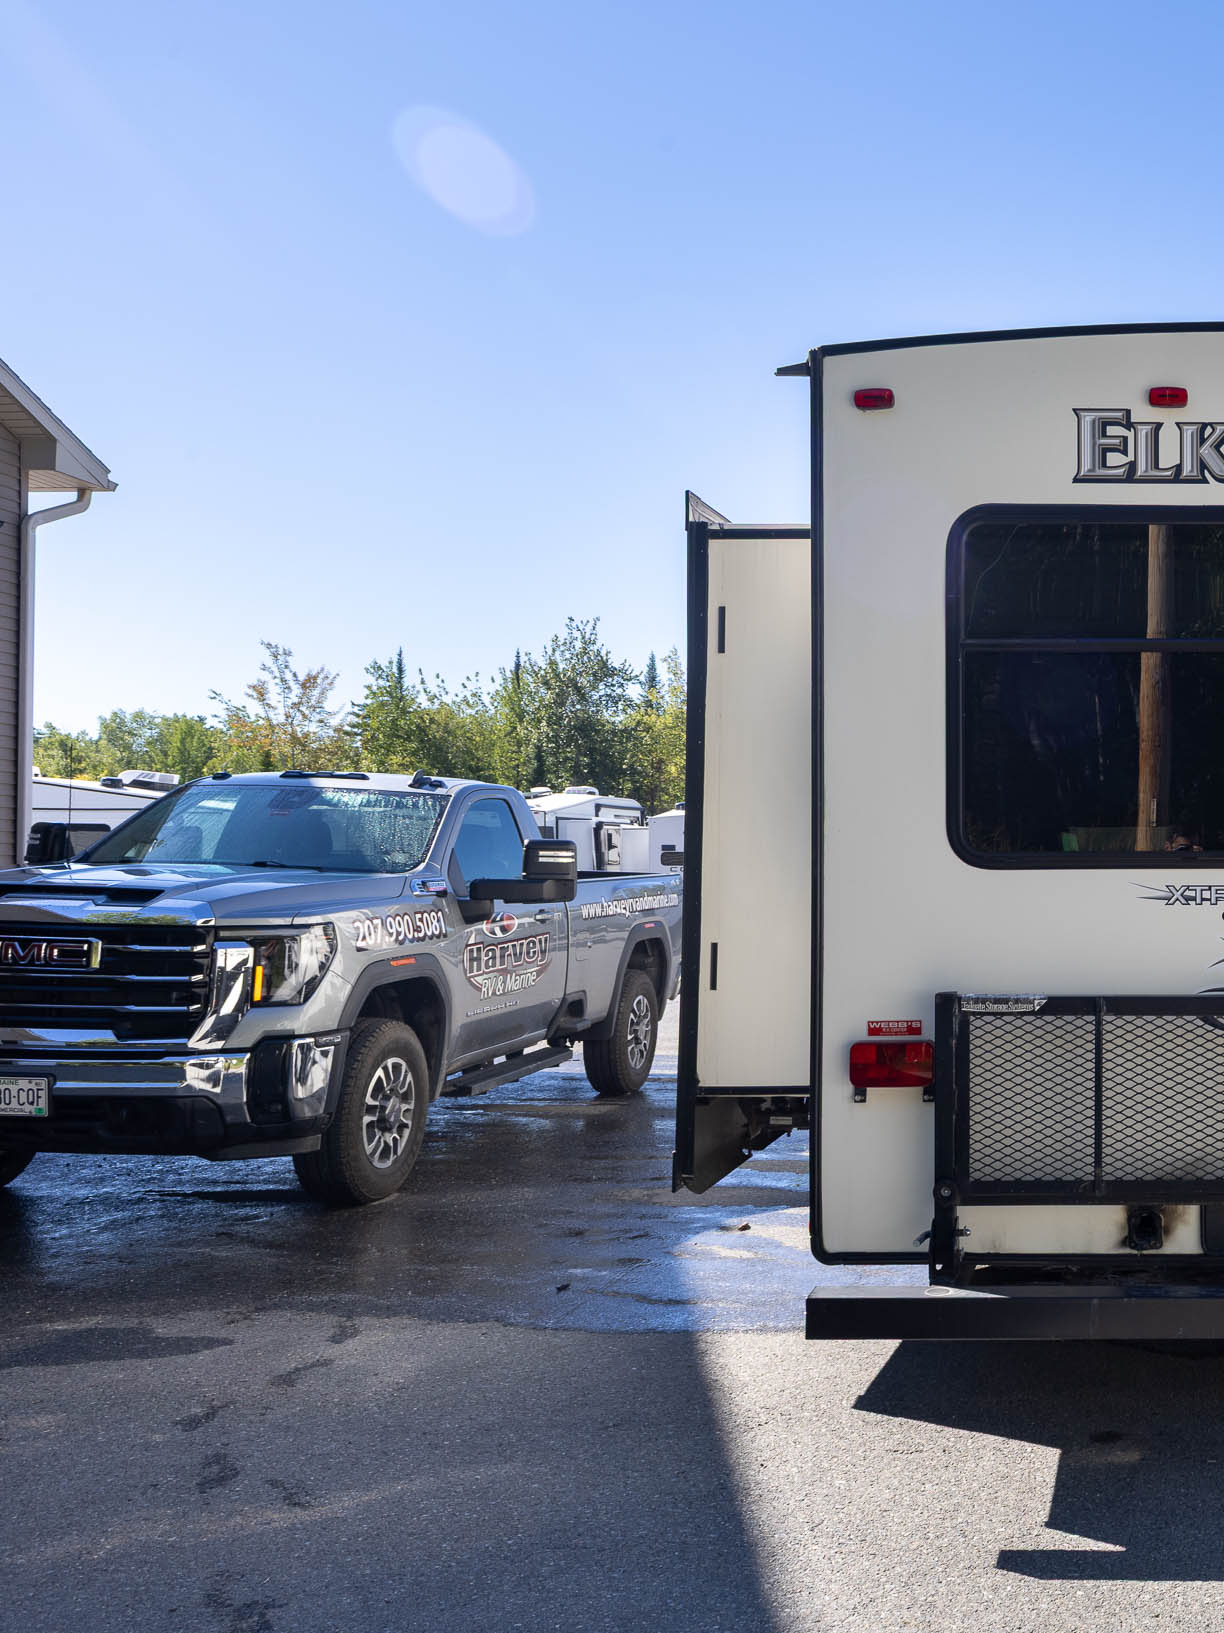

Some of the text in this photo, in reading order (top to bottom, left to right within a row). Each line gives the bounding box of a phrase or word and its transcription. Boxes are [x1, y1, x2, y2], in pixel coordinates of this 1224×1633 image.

[352, 909, 448, 950] 207.990.5081
[0, 940, 89, 965] MC
[465, 932, 550, 977] Harvey
[480, 971, 538, 1000] RV & Marine
[0, 1087, 44, 1106] 0-CQF
